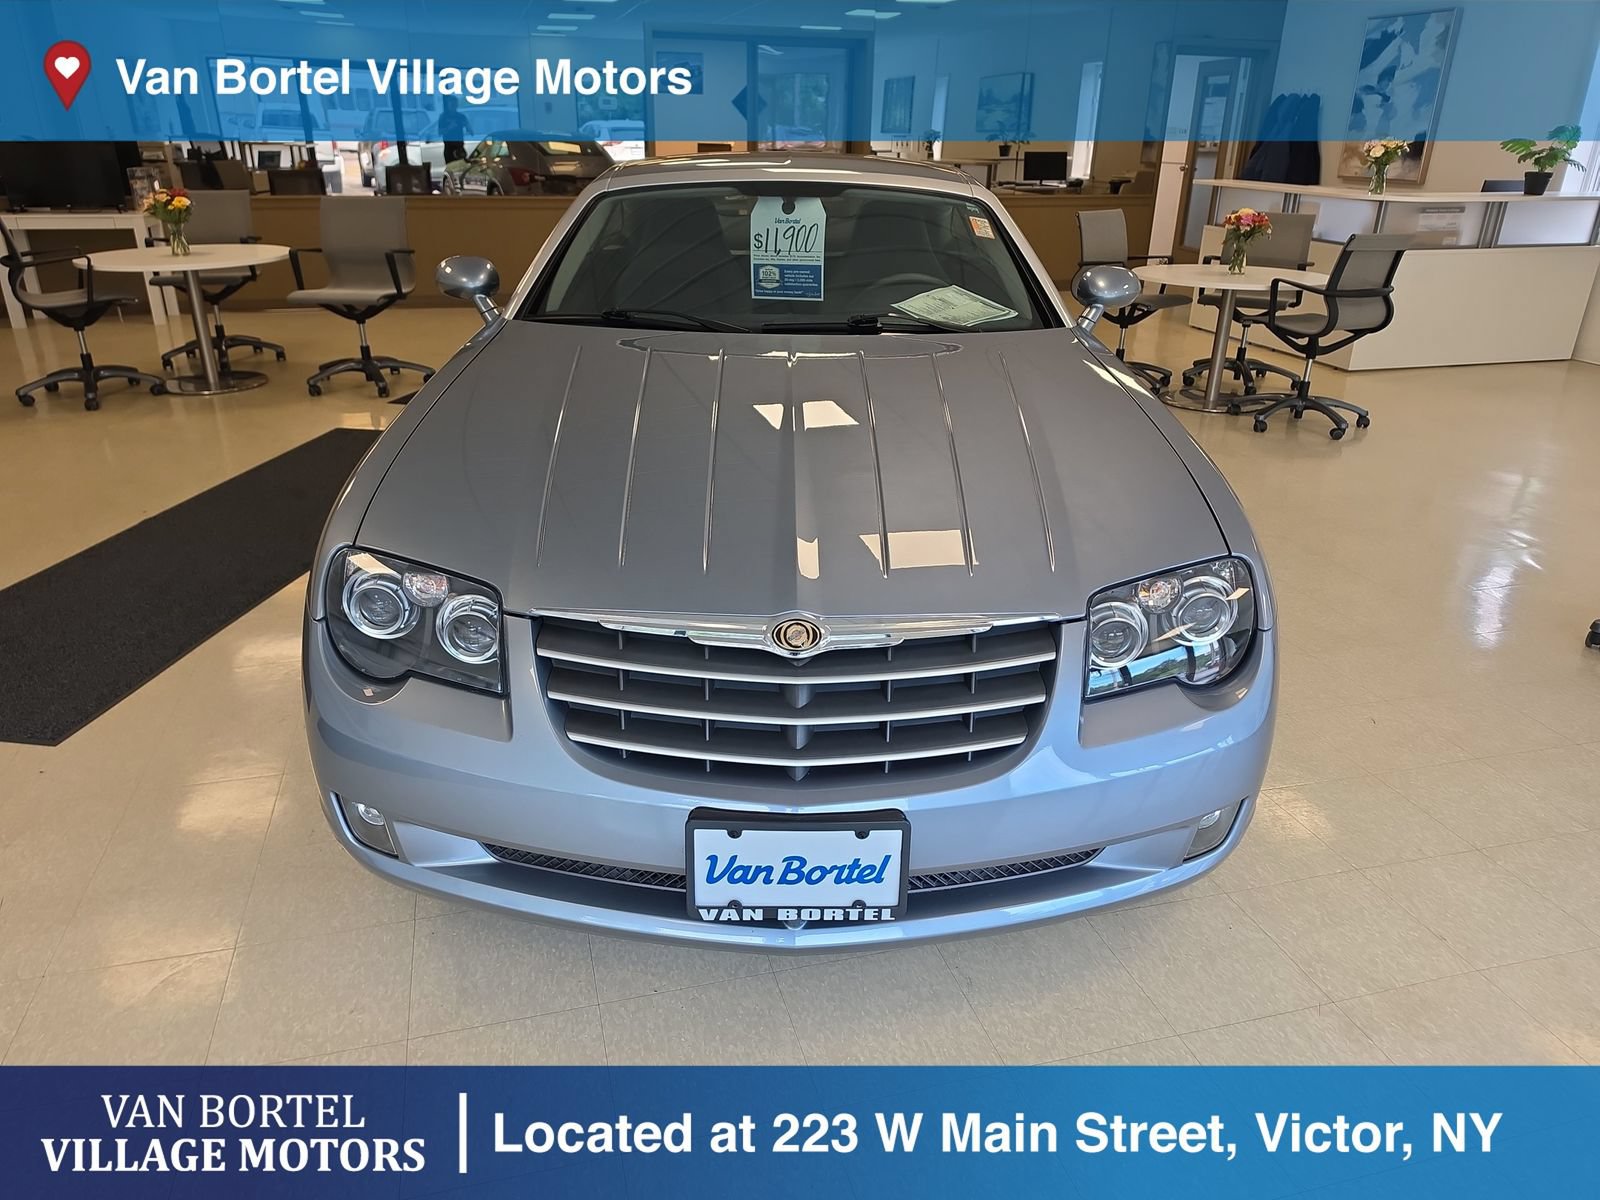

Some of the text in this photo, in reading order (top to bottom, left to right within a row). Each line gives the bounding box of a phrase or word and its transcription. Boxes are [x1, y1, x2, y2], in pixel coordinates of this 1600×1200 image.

[753, 223, 819, 256] $11,900
[705, 854, 892, 886] Van Bortel
[698, 907, 897, 921] VAN BORTEL
